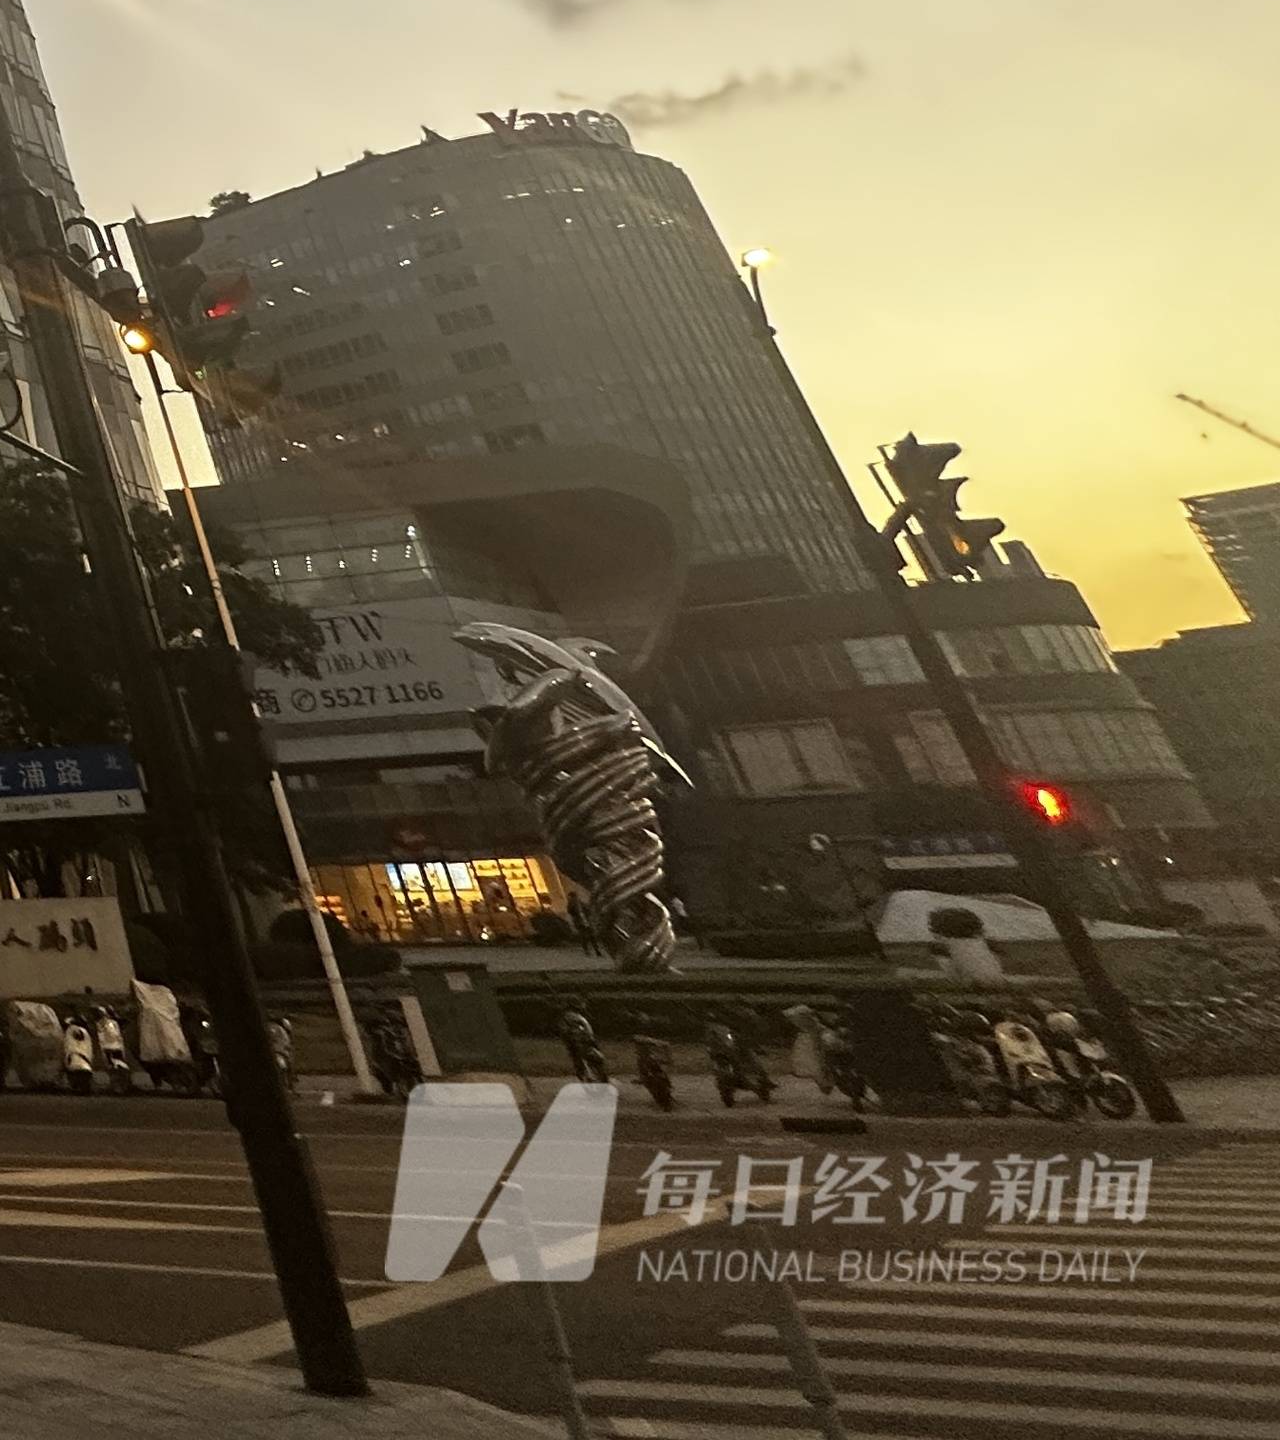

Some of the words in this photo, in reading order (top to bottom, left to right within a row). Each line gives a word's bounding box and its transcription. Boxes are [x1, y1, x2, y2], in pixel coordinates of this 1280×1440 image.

[320, 686, 377, 709] 5527
[387, 680, 443, 705] 1166
[103, 752, 122, 771] 北
[116, 794, 131, 808] N
